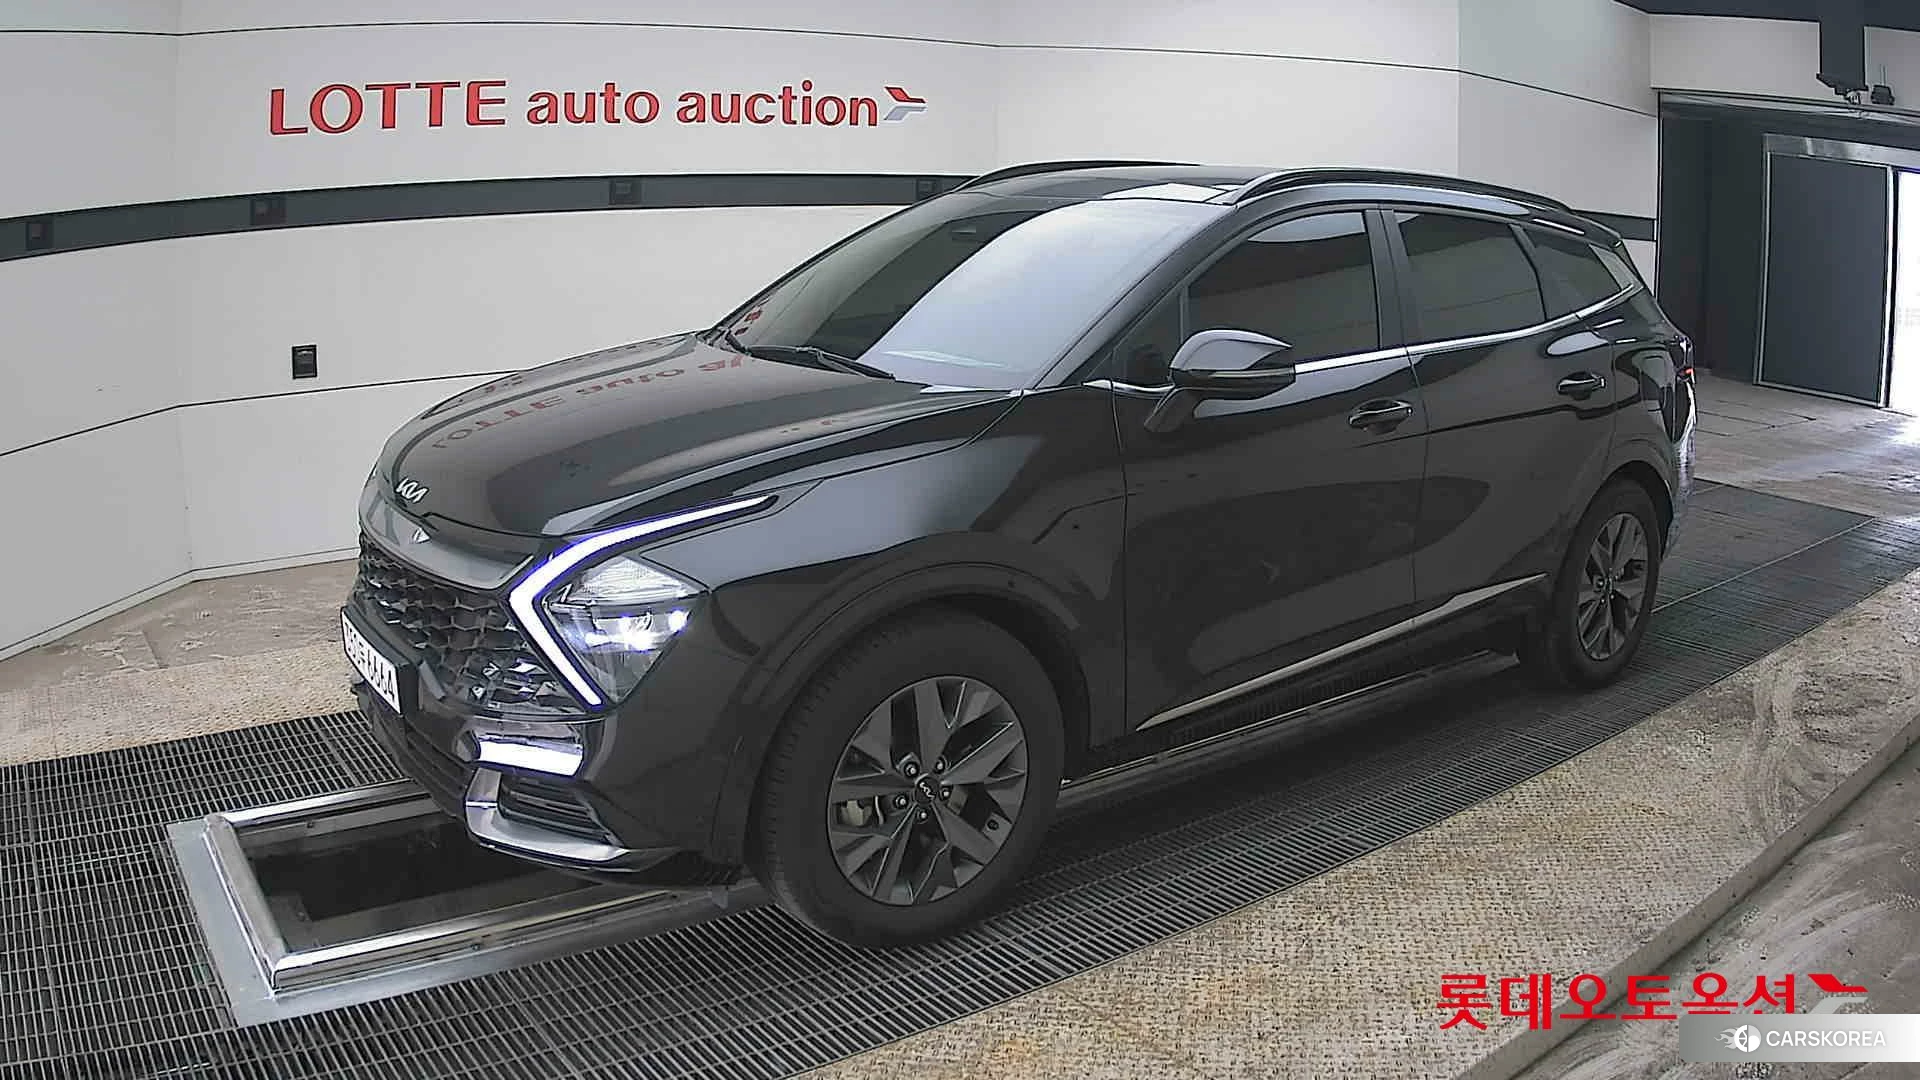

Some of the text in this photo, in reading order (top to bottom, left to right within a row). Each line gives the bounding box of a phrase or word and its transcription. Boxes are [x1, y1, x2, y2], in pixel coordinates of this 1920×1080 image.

[269, 80, 878, 136] LOTTE auto auction
[395, 477, 429, 503] KIA
